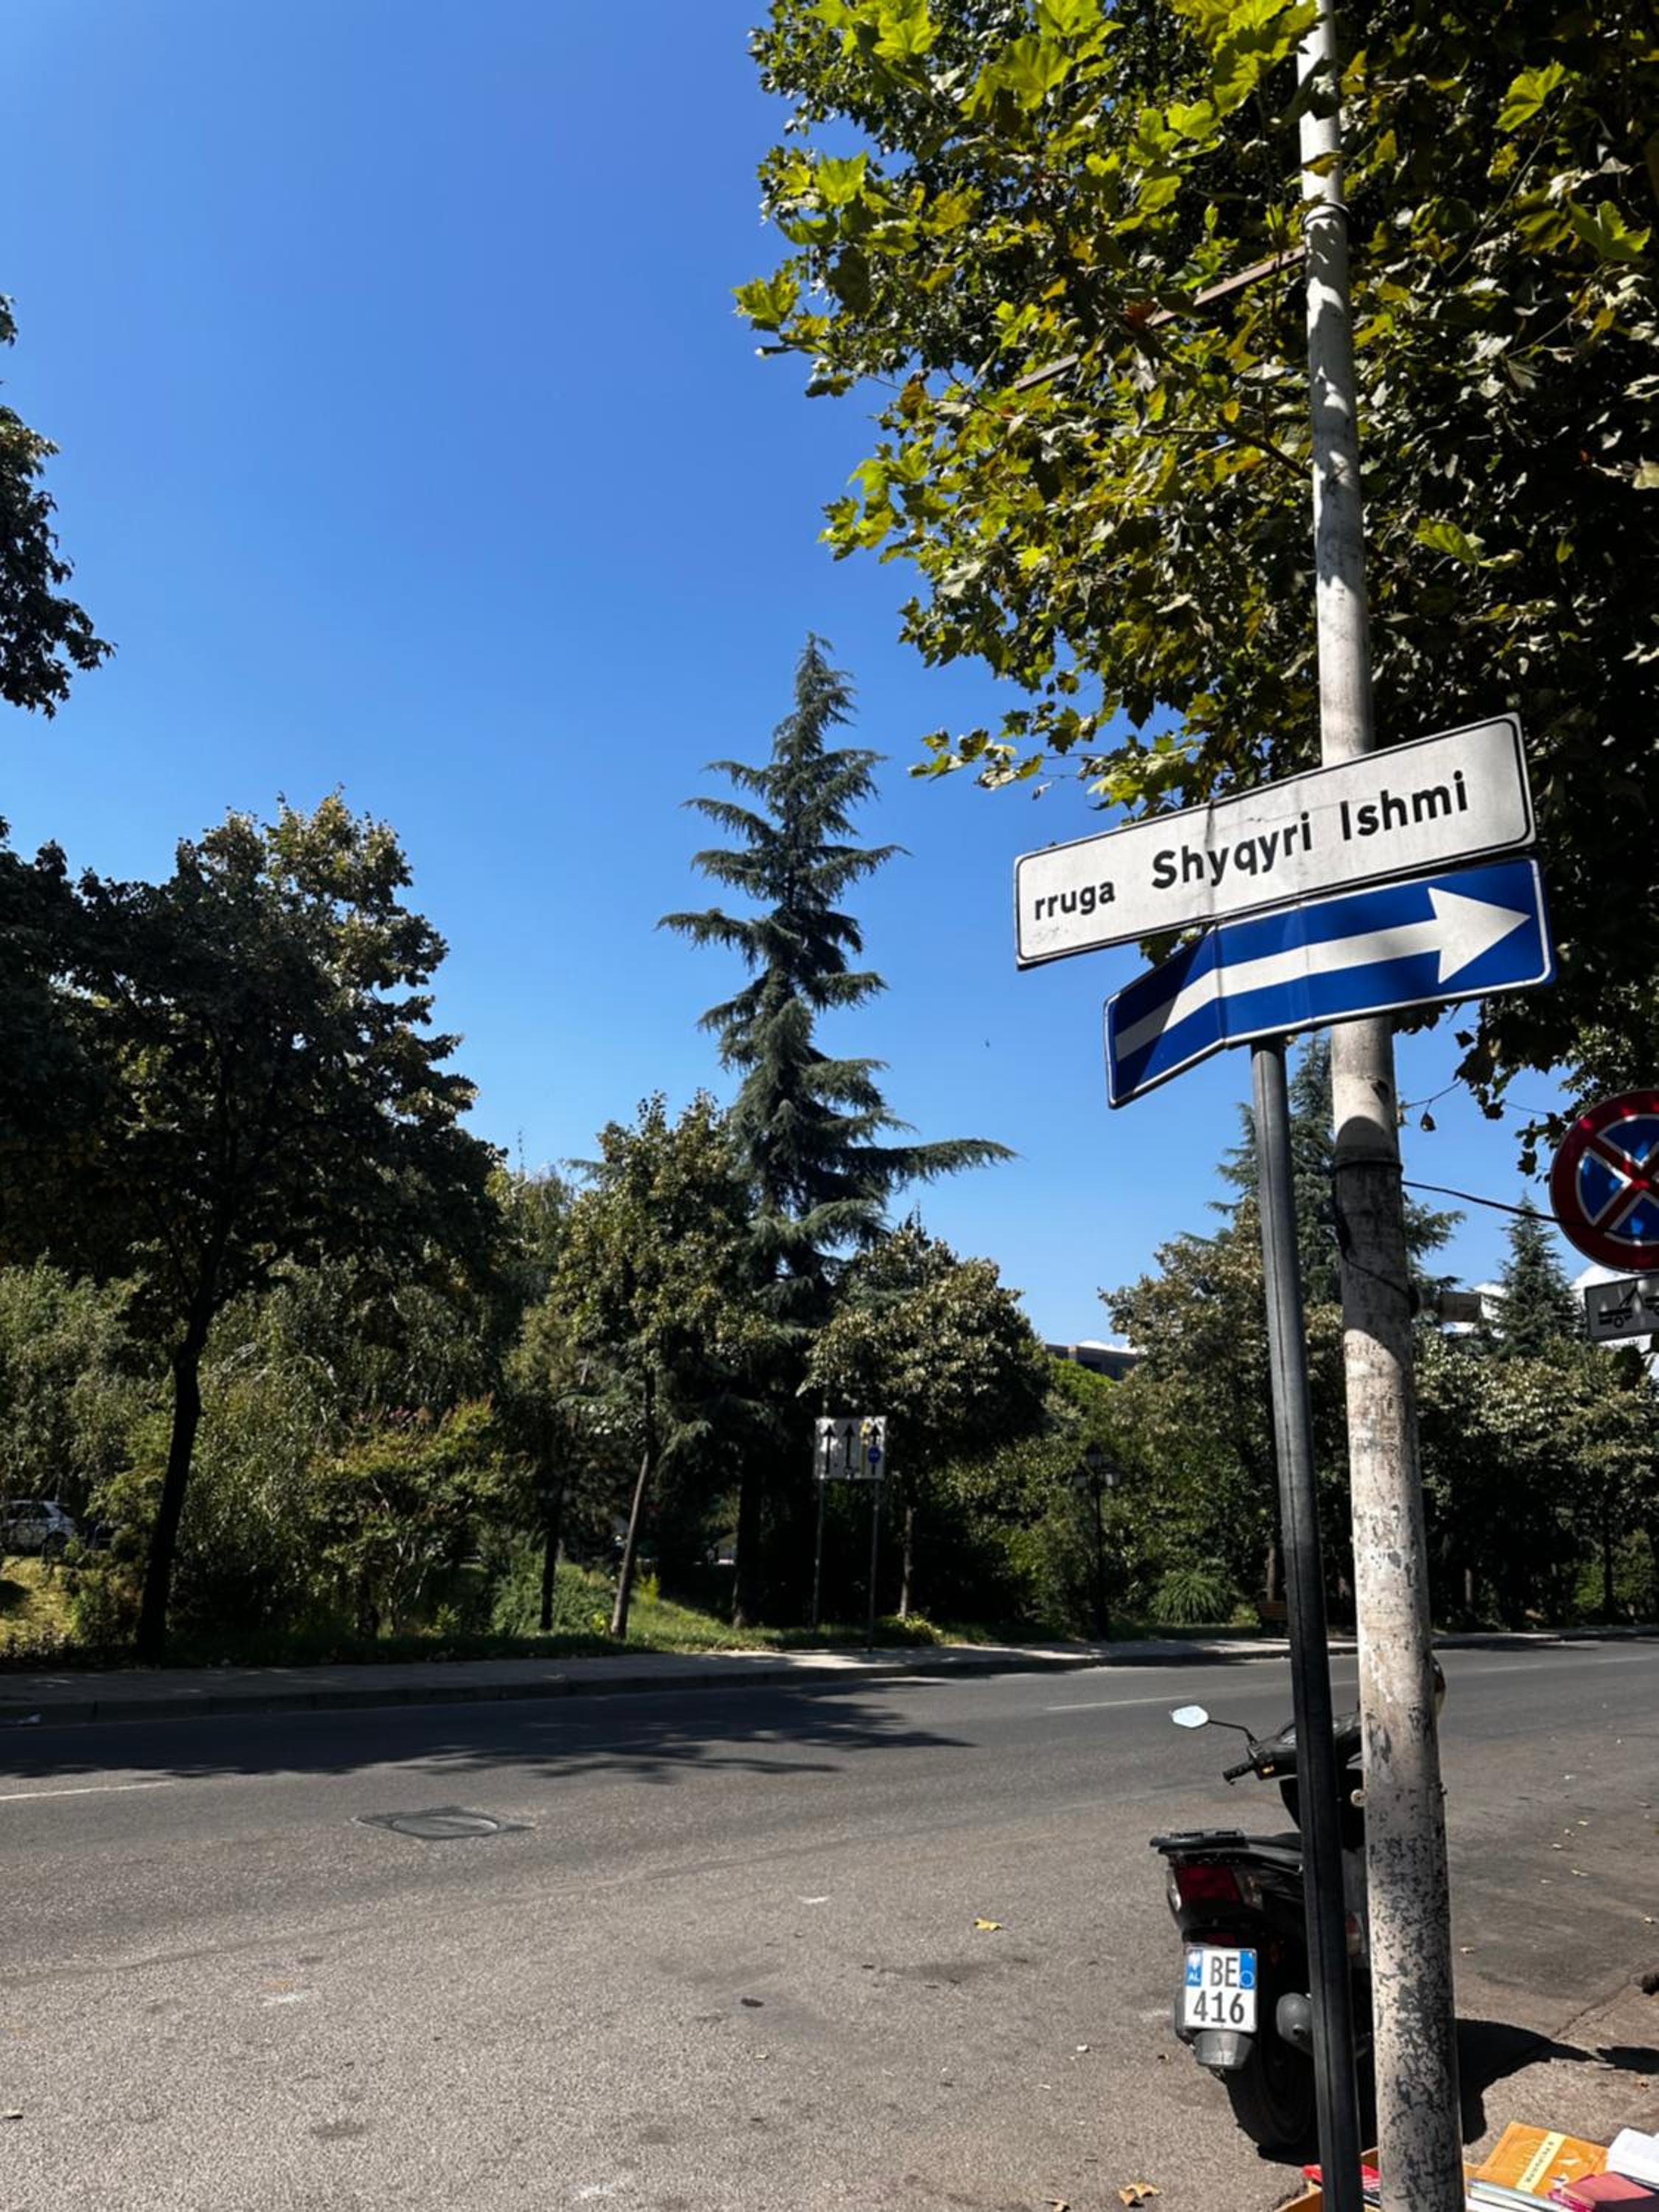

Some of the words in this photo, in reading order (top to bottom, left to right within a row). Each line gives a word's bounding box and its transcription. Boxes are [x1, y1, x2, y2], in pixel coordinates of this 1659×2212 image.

[1034, 881, 1116, 921] rruga
[1151, 812, 1312, 889] Shyqyri
[1340, 770, 1468, 842] Ishmi
[1210, 1956, 1238, 1987] BE
[1193, 1990, 1245, 2024] 416
